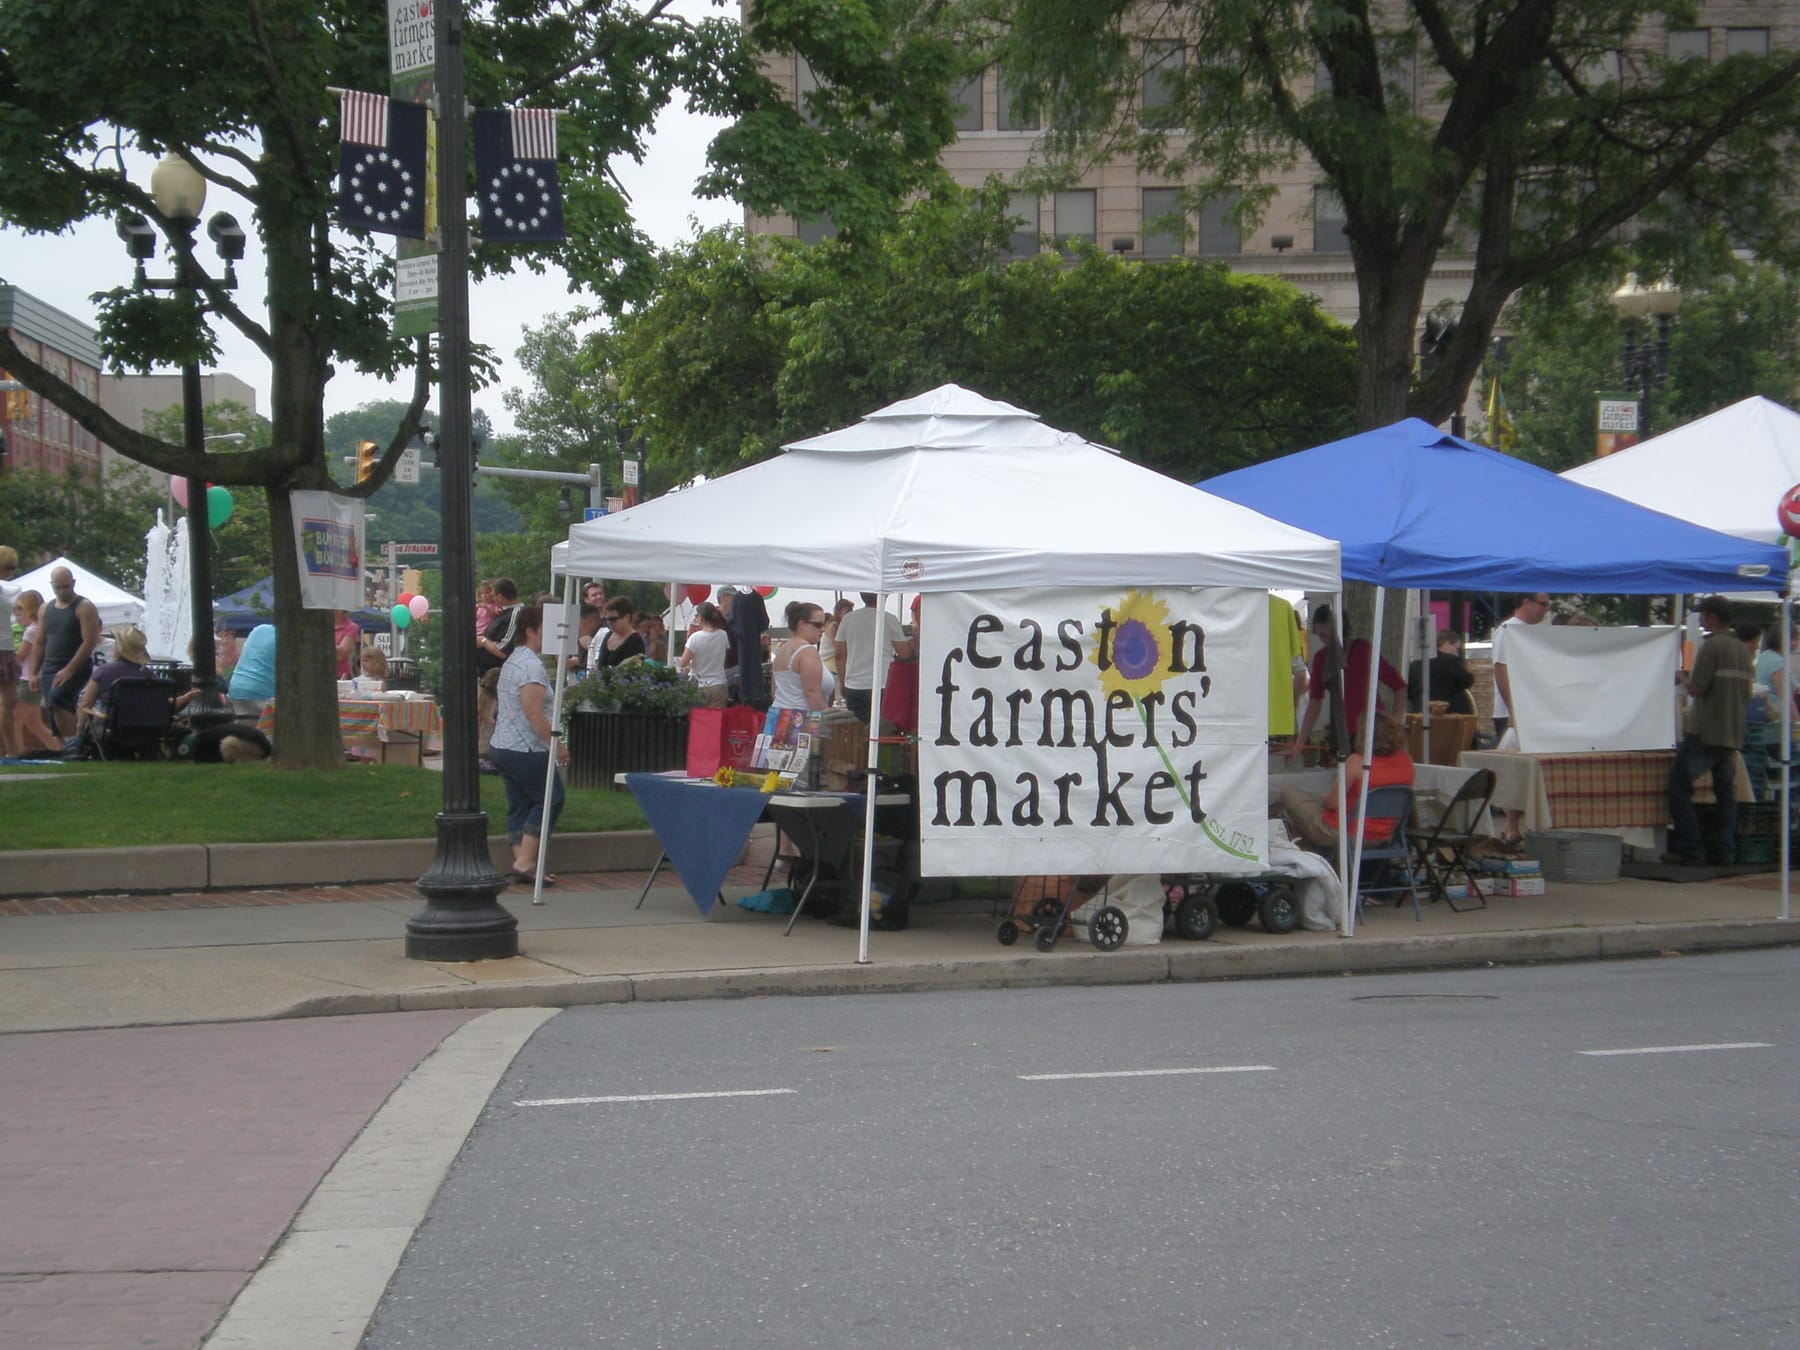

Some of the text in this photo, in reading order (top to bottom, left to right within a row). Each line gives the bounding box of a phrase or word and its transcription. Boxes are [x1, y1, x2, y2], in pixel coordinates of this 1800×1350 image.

[395, 41, 433, 70] marke
[967, 609, 1207, 672] easton
[935, 647, 1211, 747] farmers'
[931, 743, 1207, 826] market
[1229, 830, 1254, 853] 1752
